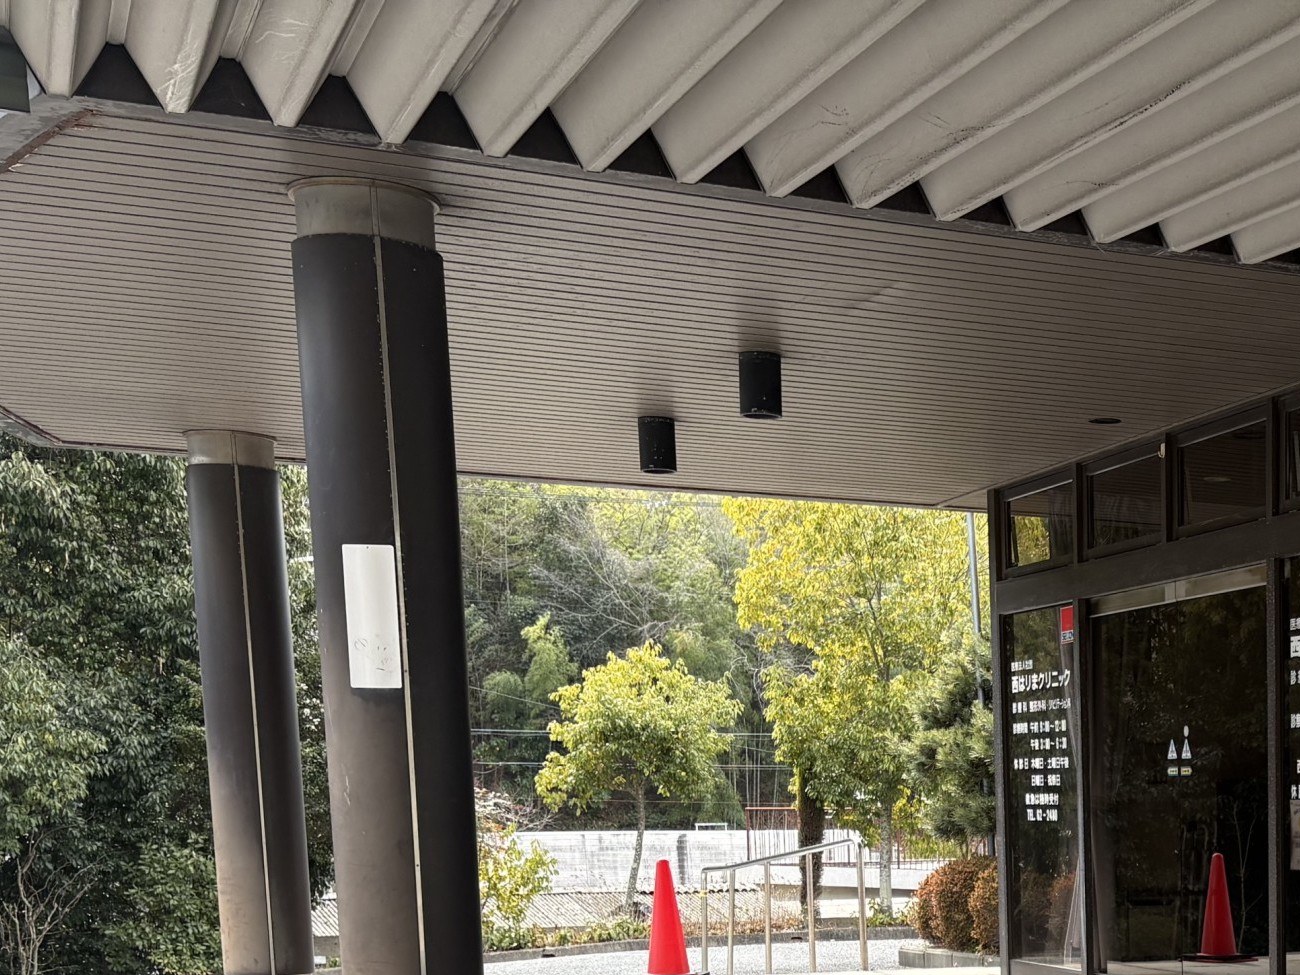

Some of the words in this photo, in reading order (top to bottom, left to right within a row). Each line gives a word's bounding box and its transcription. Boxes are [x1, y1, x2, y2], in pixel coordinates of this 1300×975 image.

[1011, 669, 1071, 694] 西はりまクリニック
